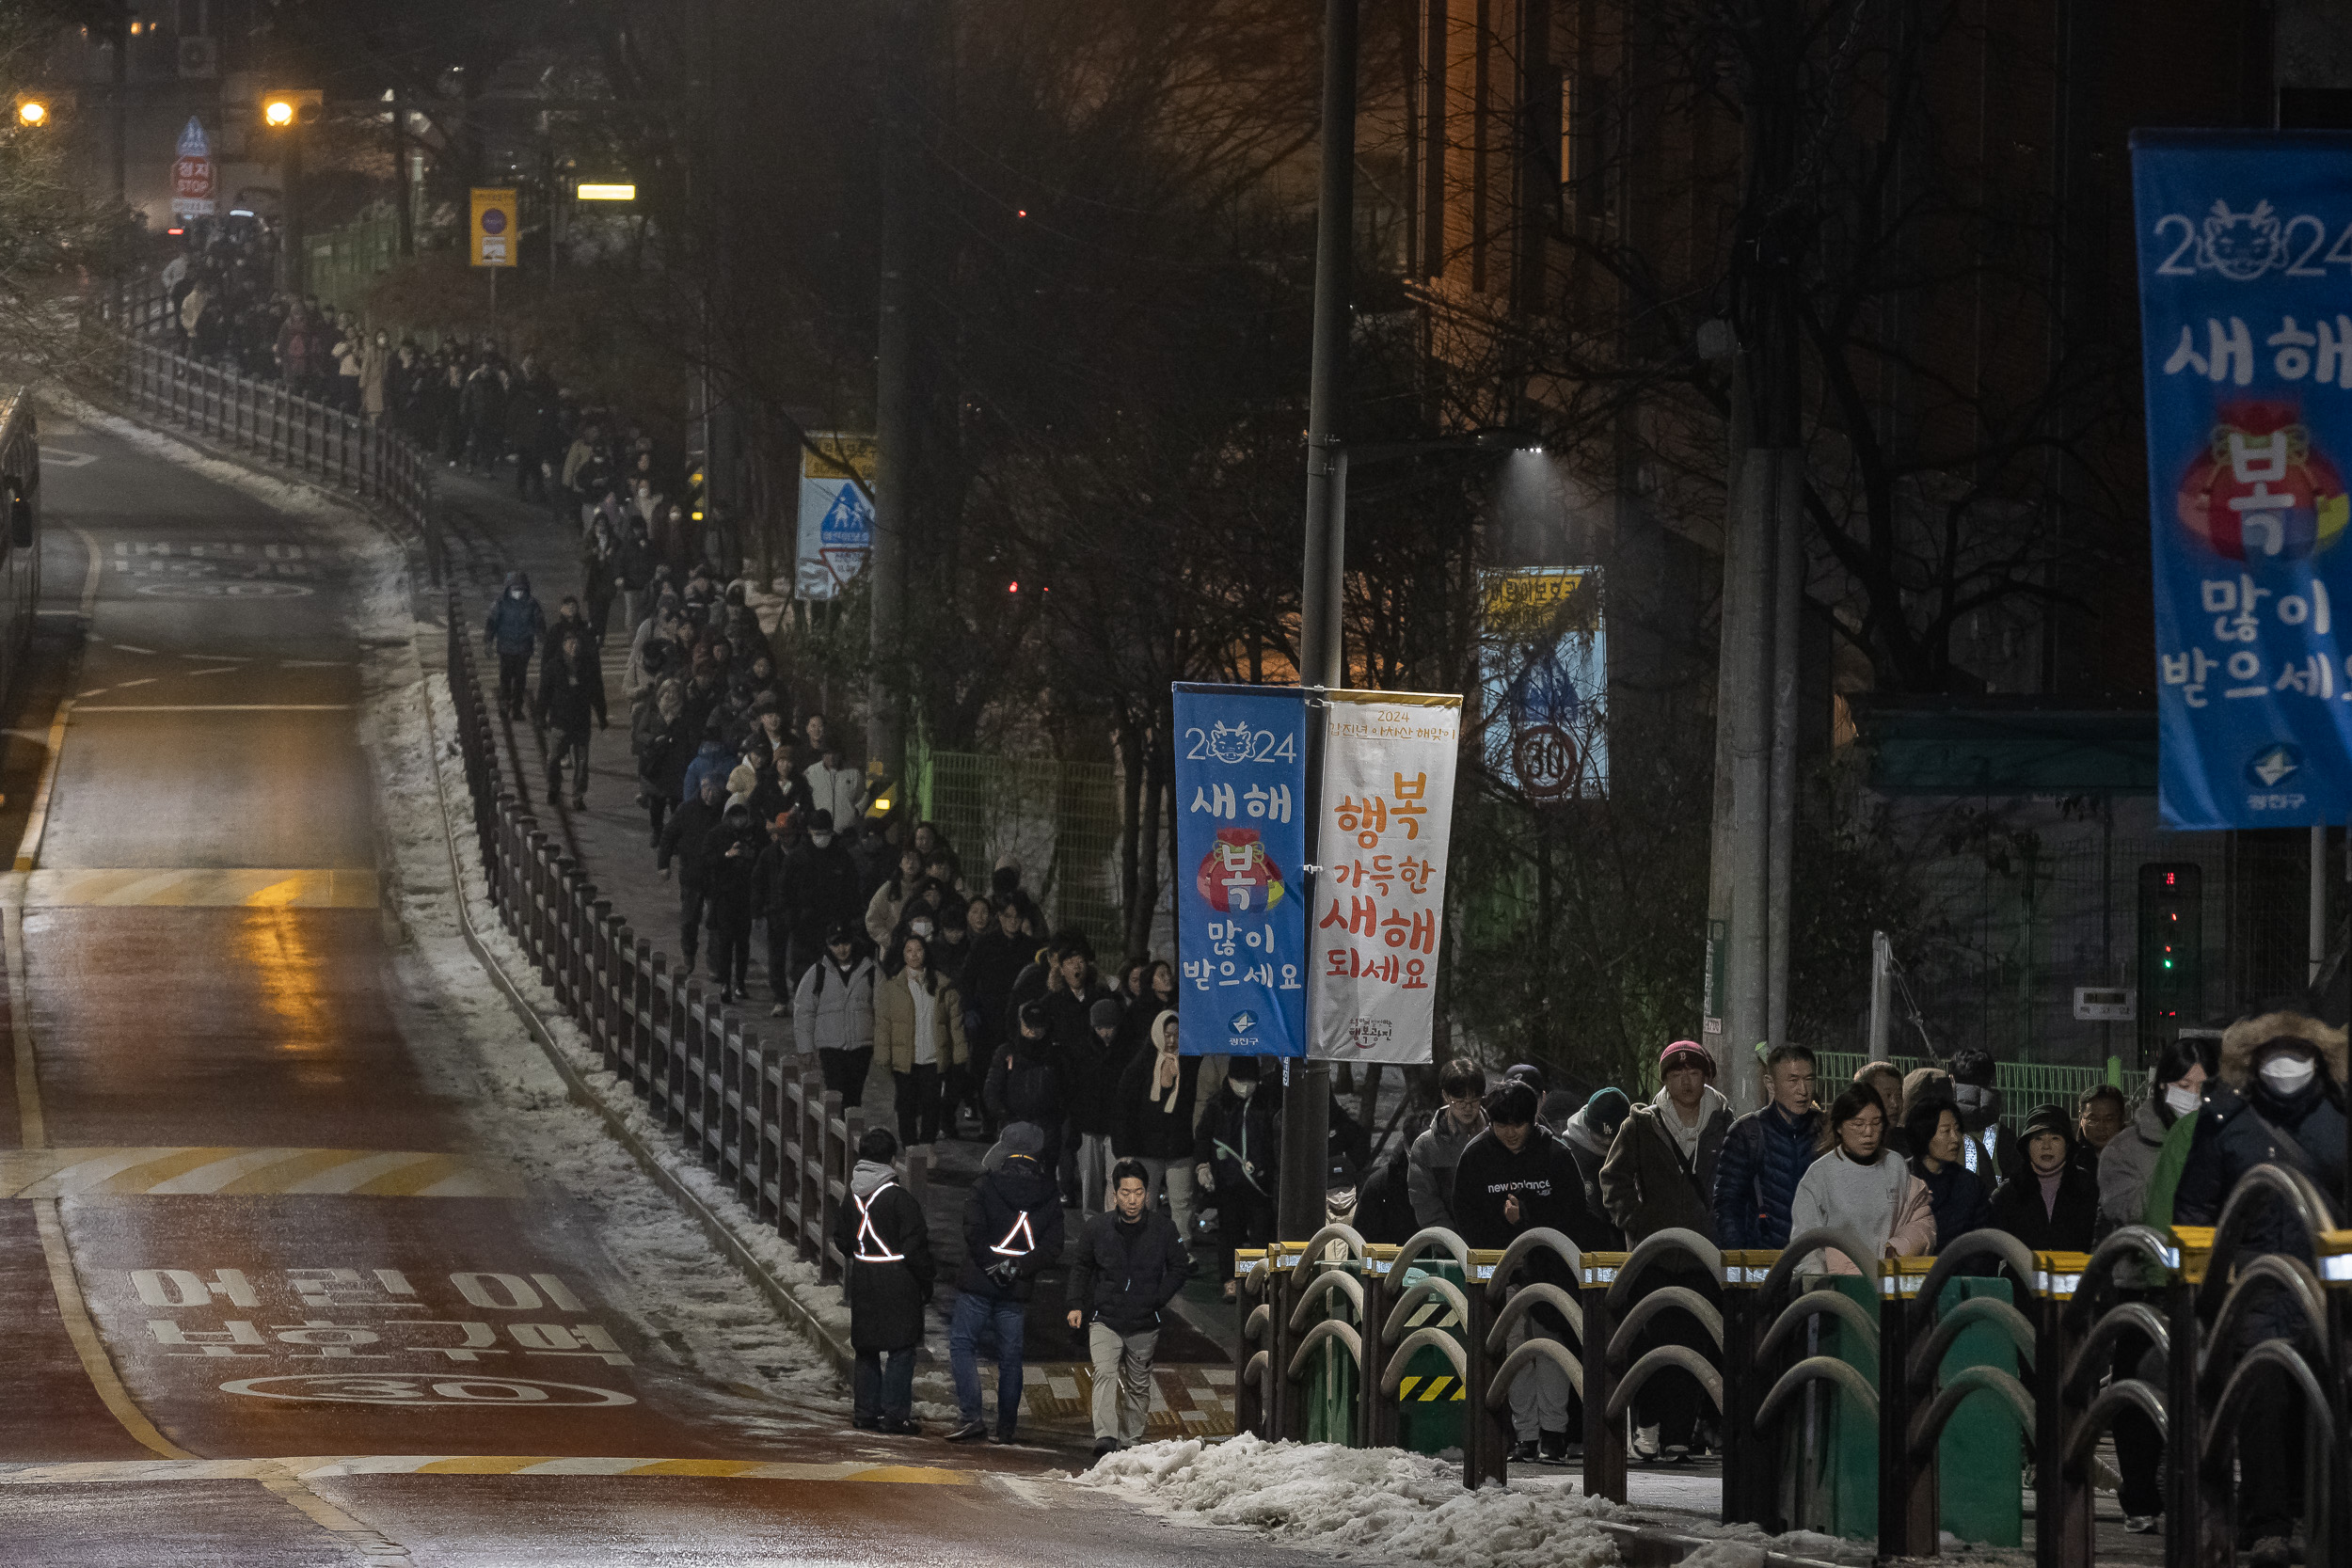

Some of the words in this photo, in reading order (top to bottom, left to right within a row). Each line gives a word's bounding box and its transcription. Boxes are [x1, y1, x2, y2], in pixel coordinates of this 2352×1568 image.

[2164, 314, 2352, 389] 새해
[2227, 430, 2296, 557] 복
[2201, 573, 2331, 642] 많이
[2162, 646, 2352, 708] 받으세
[1372, 725, 1413, 740] 아차산
[1417, 727, 1456, 741] 해맞이
[1377, 710, 1410, 723] 2024
[1526, 740, 1563, 779] 30
[1190, 783, 1293, 824] 새해
[1333, 771, 1428, 850] 행복
[1221, 844, 1257, 911] 복
[1333, 854, 1437, 897] 가득한
[1208, 919, 1275, 957] 많이
[1319, 895, 1436, 955] 새해
[1183, 958, 1302, 991] 받으세요
[1326, 946, 1429, 990] 되세요
[1229, 1037, 1260, 1046] 광진구
[1348, 1025, 1392, 1044] 행복광진
[1679, 1052, 1687, 1061] B
[1602, 1122, 1613, 1134] LA
[1487, 1182, 1509, 1194] new
[129, 1268, 587, 1311] 어린이
[145, 1319, 635, 1366] 보호구역
[301, 1379, 549, 1402] 30
